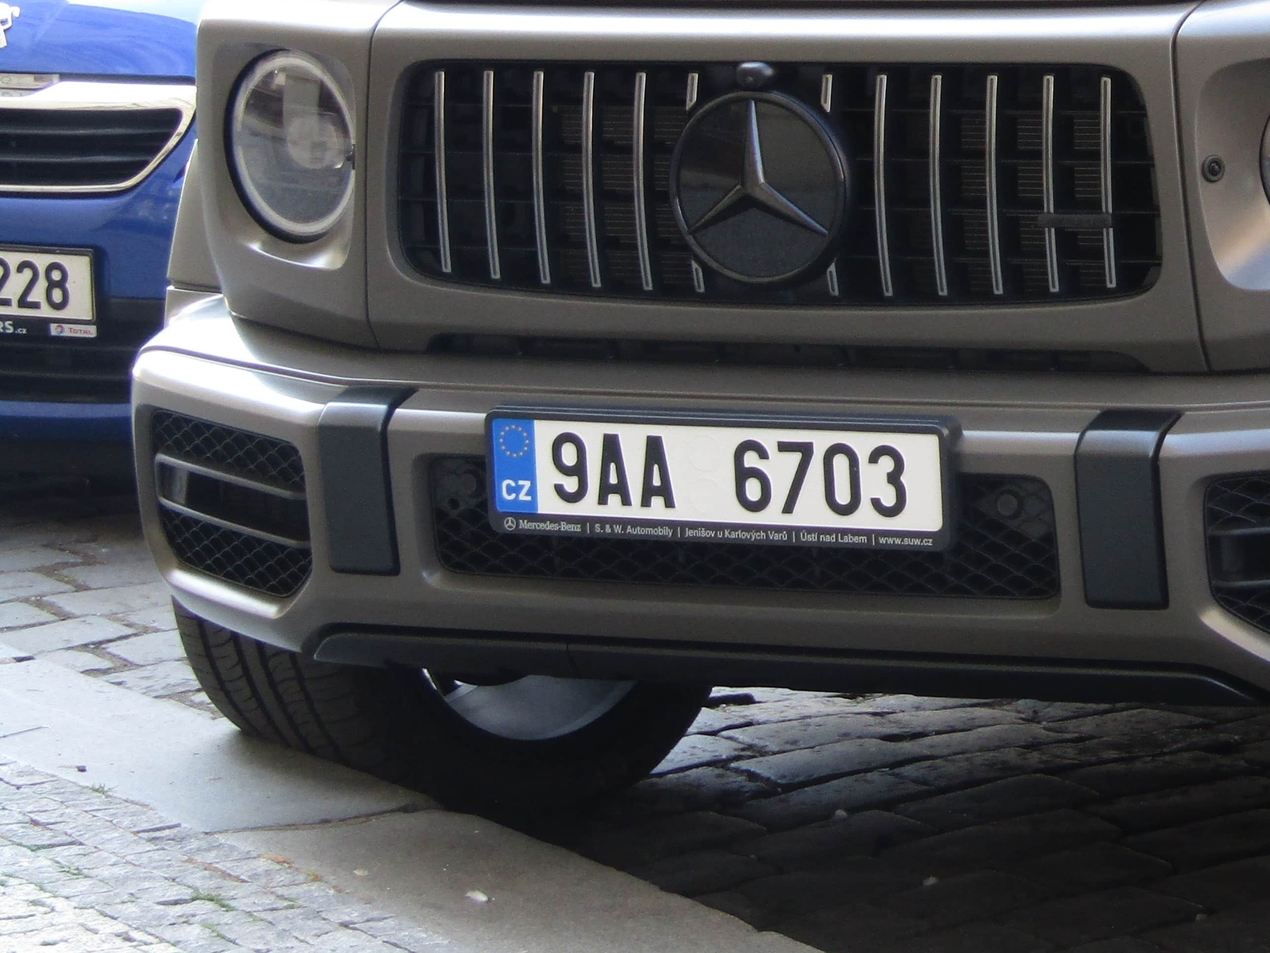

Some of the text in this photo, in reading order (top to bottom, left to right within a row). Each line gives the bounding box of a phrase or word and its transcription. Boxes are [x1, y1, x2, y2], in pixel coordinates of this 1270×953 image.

[551, 431, 907, 518] 9AA 6703
[502, 479, 532, 501] CZ
[519, 520, 933, 546] Mercedes-Benz S. & W. Automobily Jenišov u Karlových Varů Ústí nad Labem www.suw.cz
